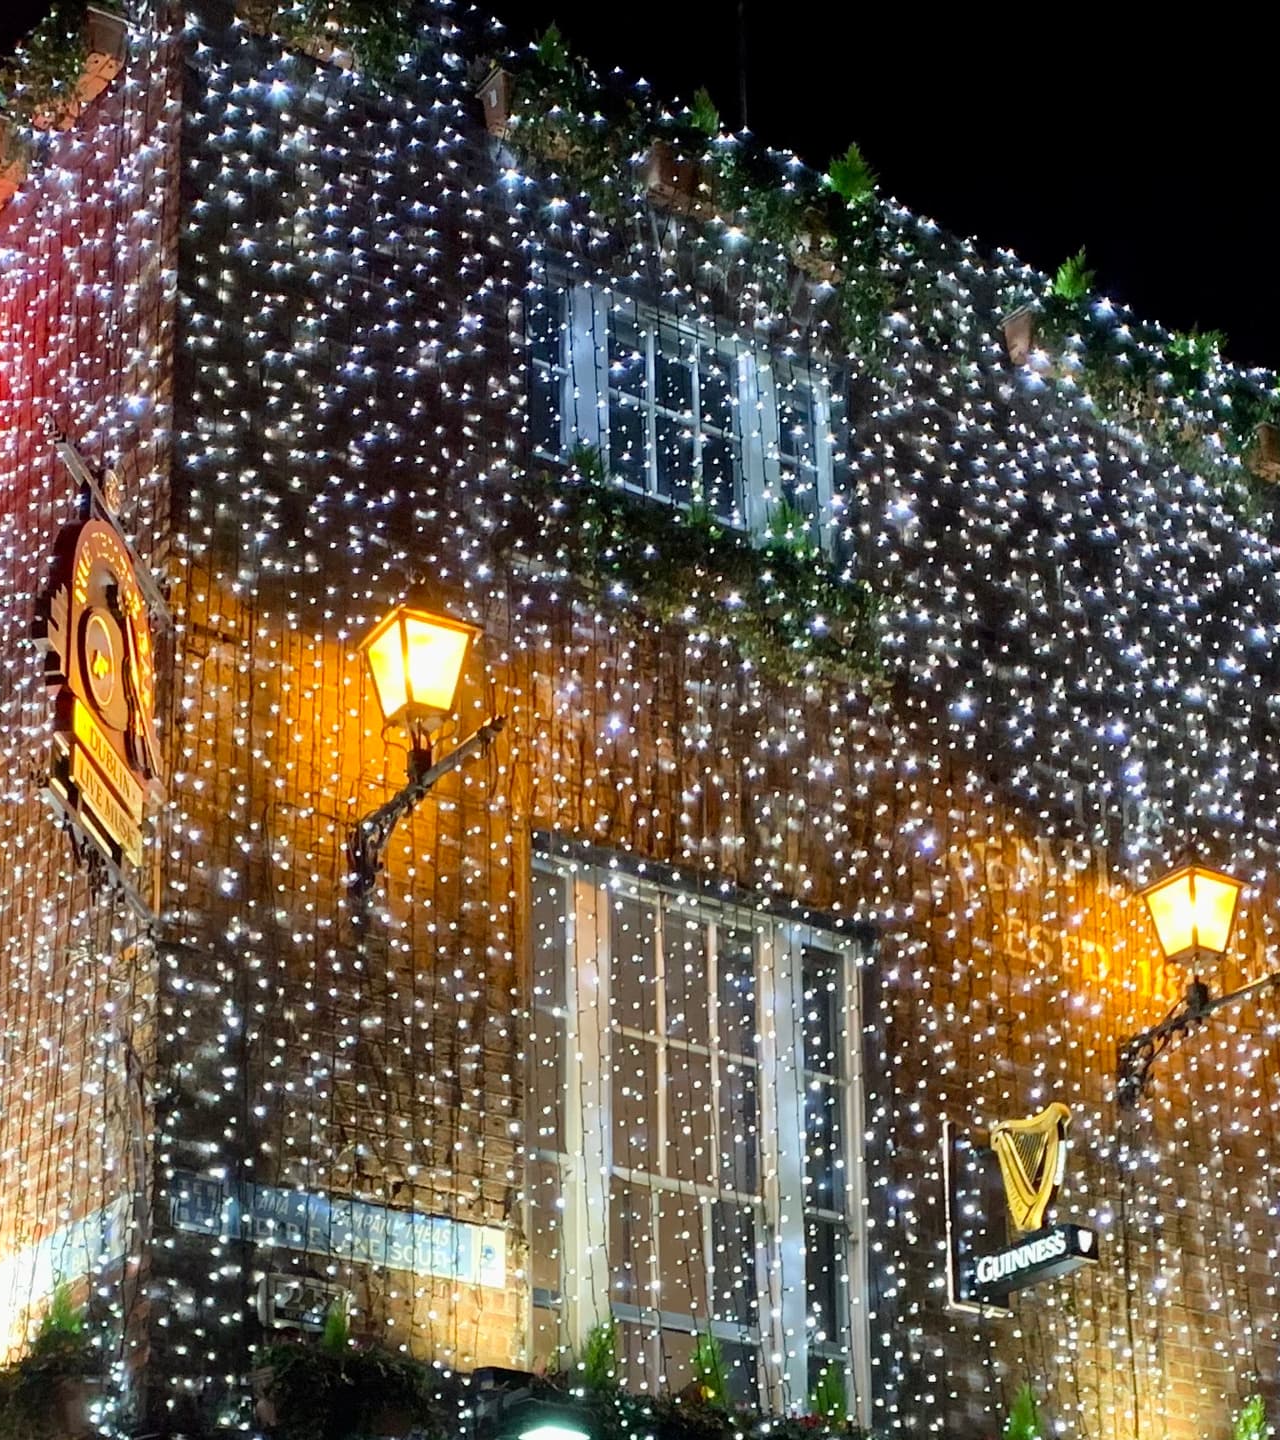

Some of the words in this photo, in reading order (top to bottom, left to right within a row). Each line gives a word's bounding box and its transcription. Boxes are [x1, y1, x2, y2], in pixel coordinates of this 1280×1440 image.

[79, 759, 103, 808] LIVE
[90, 726, 131, 798] DUBLIN
[976, 1229, 1068, 1284] GUINNESS
